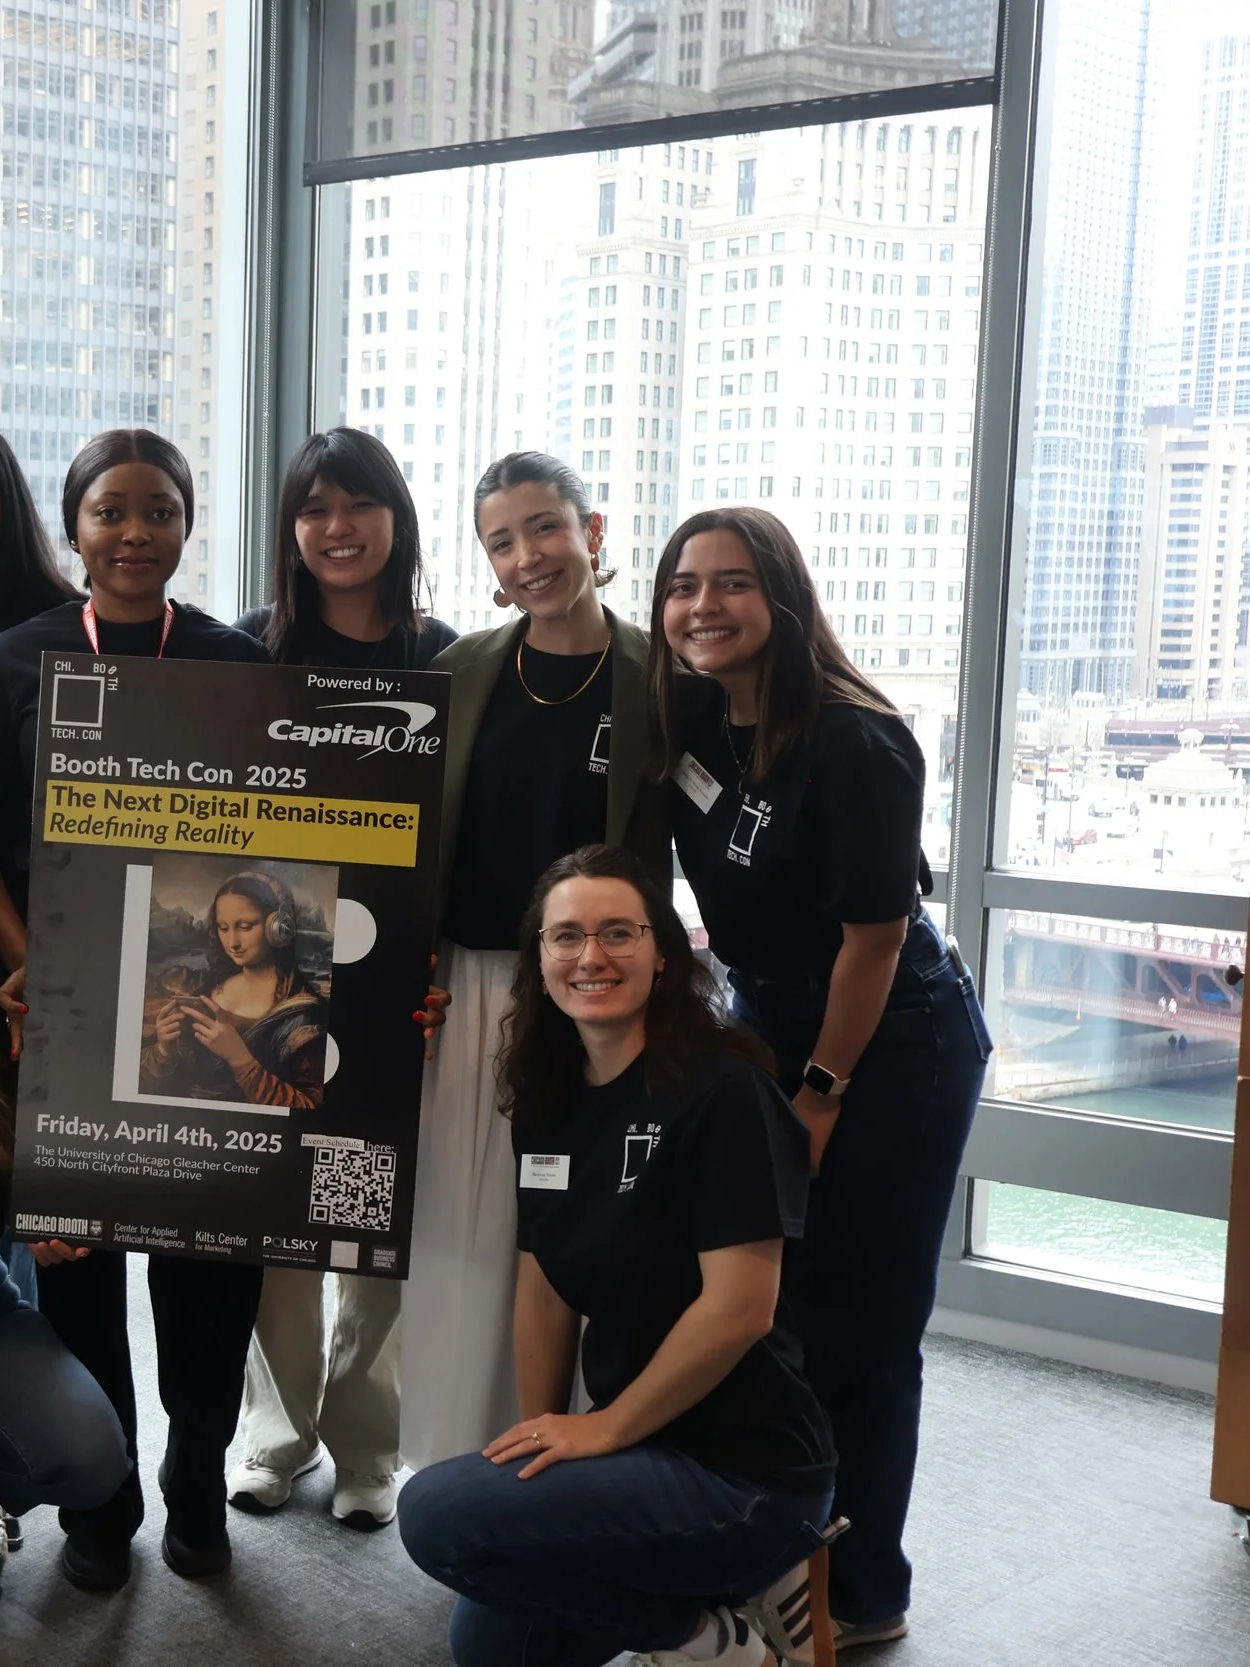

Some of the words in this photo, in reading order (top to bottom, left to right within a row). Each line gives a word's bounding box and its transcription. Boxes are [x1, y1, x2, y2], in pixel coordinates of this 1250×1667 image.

[54, 660, 75, 672] CHI.
[307, 674, 371, 691] Powered
[51, 727, 80, 740] TECH.
[82, 729, 102, 741] CON
[50, 752, 121, 777] Booth
[127, 757, 180, 781] Tech
[187, 761, 233, 784] Con
[245, 765, 306, 789] 2025
[52, 785, 96, 808] The
[103, 788, 162, 813] Next
[169, 793, 249, 820] Digital
[256, 798, 414, 830] Renaissance:
[50, 812, 169, 844] Redefining
[175, 821, 254, 850] Reality
[37, 1113, 109, 1141] Friday,
[114, 1120, 169, 1145] April
[174, 1125, 218, 1151] 4th,
[224, 1130, 283, 1154] 2025
[302, 1136, 324, 1145] Event
[367, 1141, 395, 1153] here:
[35, 1144, 55, 1156] The
[58, 1146, 112, 1162] University
[113, 1152, 126, 1162] of
[127, 1153, 171, 1168] Chicago
[173, 1157, 221, 1171] Gleacher
[223, 1161, 261, 1175] Center
[34, 1157, 55, 1168] 450
[58, 1158, 89, 1170] North
[91, 1161, 140, 1175] Cityfront
[143, 1166, 170, 1178] Plaza
[173, 1168, 202, 1181] Drive
[16, 1213, 57, 1233] CHICAGO
[57, 1217, 88, 1235] BOOTH
[114, 1222, 138, 1233] Center
[140, 1225, 150, 1234] for
[151, 1226, 178, 1237] Applied
[113, 1232, 144, 1244] Artificial
[145, 1236, 186, 1248] Intelligence
[195, 1230, 216, 1243] Kilts
[218, 1232, 249, 1246] Center
[263, 1236, 318, 1251] POLSKY
